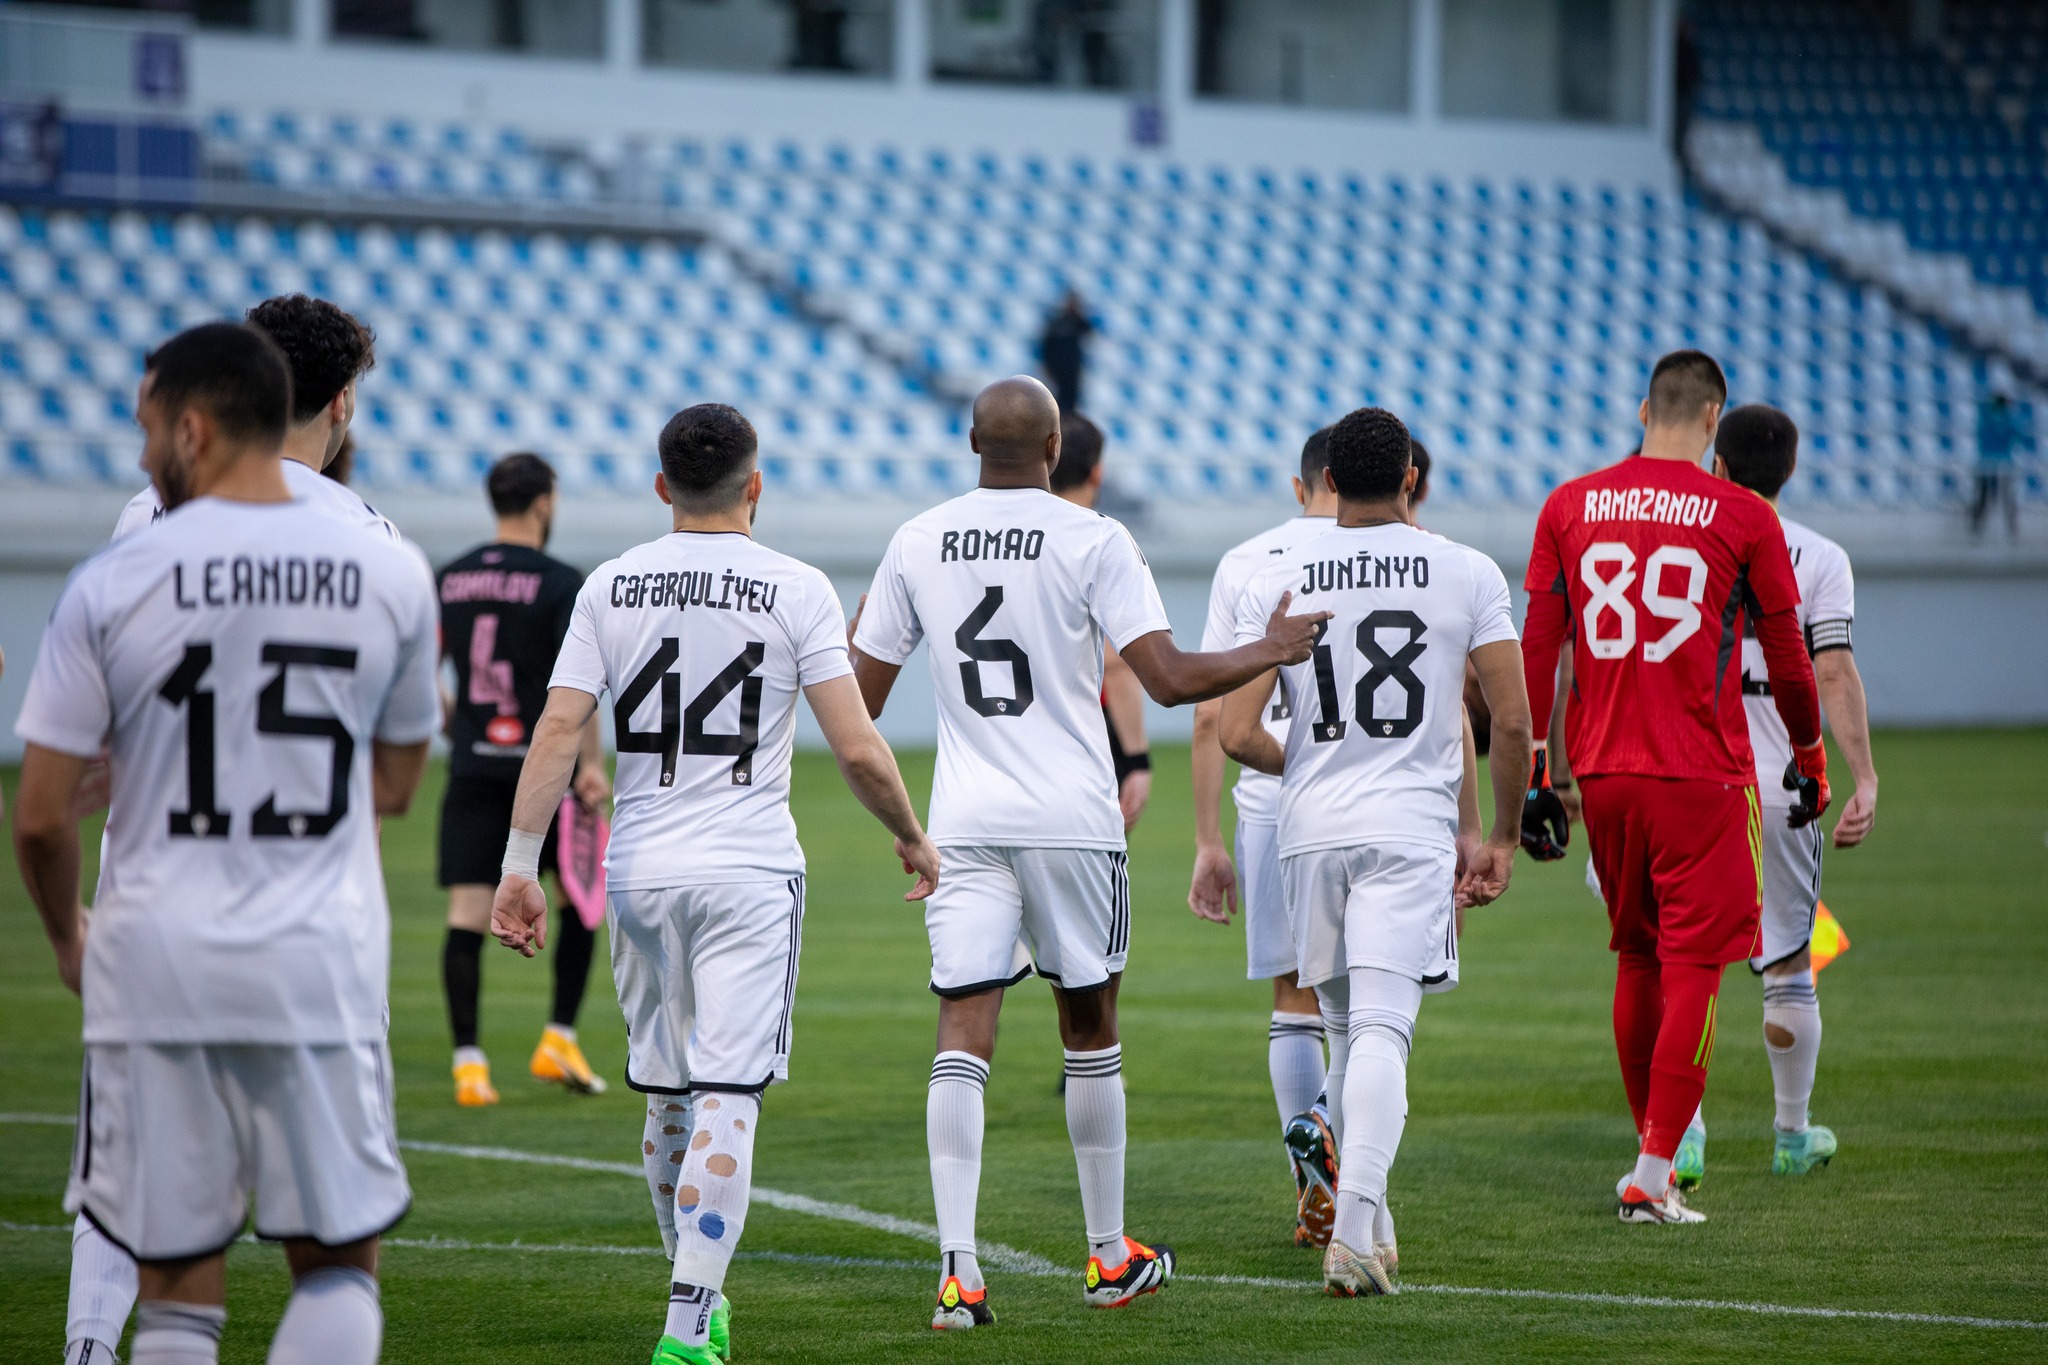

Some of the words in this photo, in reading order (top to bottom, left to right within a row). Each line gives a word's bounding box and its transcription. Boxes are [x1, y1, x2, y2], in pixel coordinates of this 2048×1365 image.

[941, 528, 1045, 563] ROMAO
[1584, 487, 1718, 529] RAMAZANOV
[173, 557, 362, 612] LEANDRO
[1580, 541, 1708, 663] 89
[468, 613, 520, 717] 4
[614, 637, 765, 788] 44
[954, 585, 1034, 718] 6
[1312, 610, 1428, 744] 18
[159, 639, 359, 837] 15
